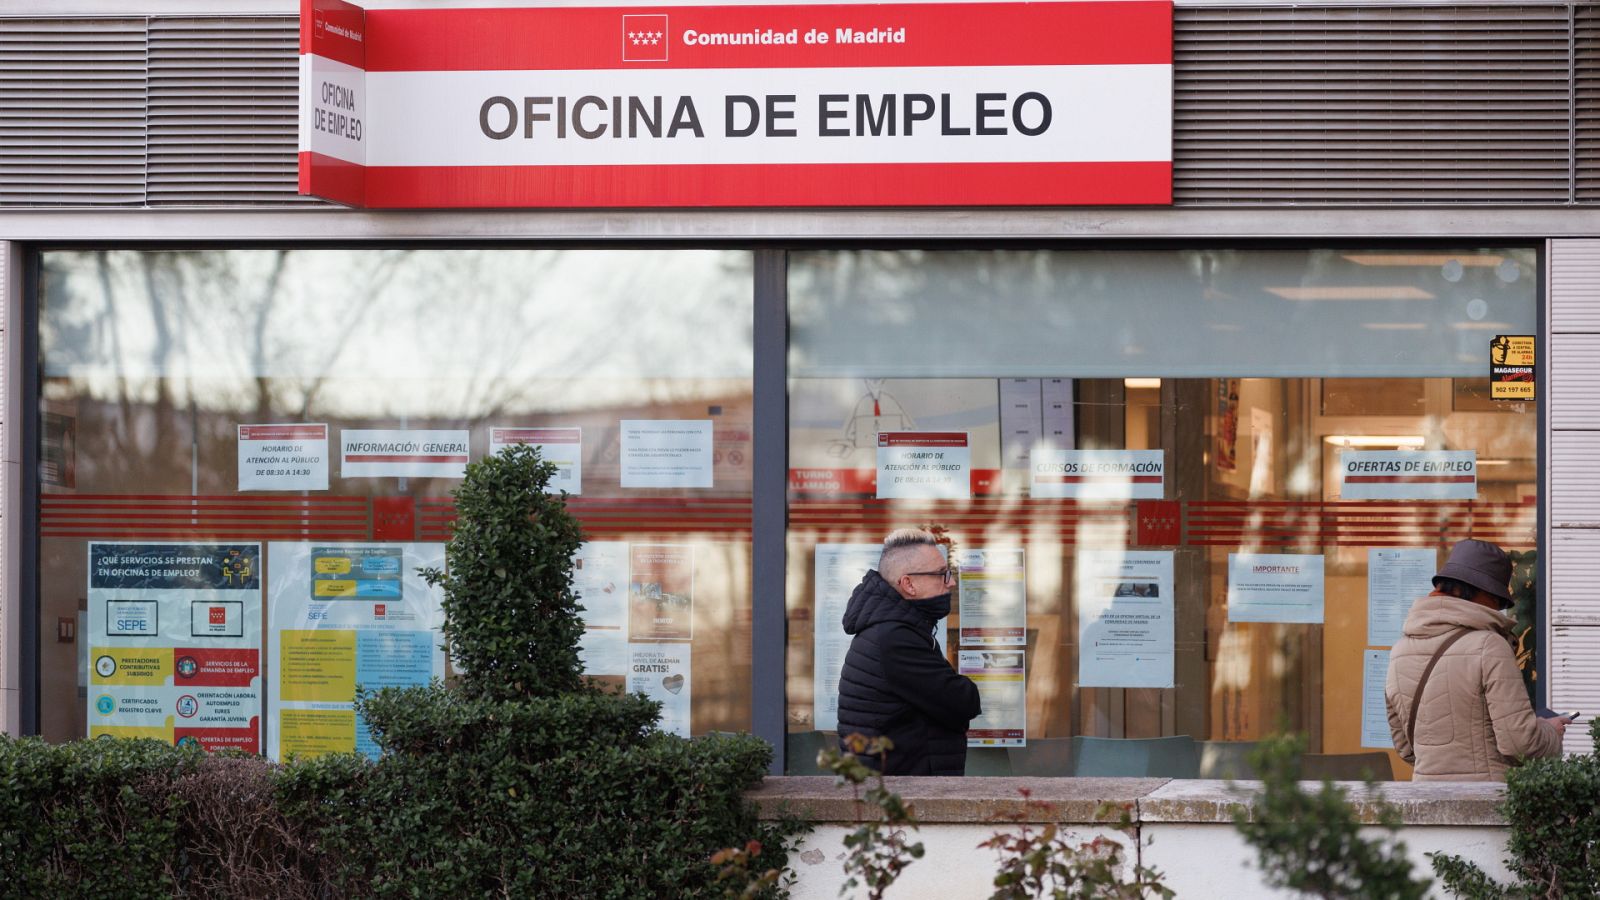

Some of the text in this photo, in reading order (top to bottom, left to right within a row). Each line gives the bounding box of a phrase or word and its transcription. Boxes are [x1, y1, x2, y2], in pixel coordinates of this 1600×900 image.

[682, 26, 906, 47] Comunidad de Madrid
[322, 81, 355, 112] OFICINA
[478, 91, 1053, 140] OFICINA DE EMPLEO
[314, 107, 362, 141] DE EMPLEO
[346, 441, 468, 453] INFORMACIÓN GENERAL
[246, 456, 280, 464] ATENCIÓN
[290, 455, 319, 464] PÚBLICO
[884, 463, 921, 471] ATENCIÓN
[931, 463, 960, 471] PÚBLICO
[1036, 460, 1162, 473] CURSOS DE FORMACIÓN
[1347, 460, 1472, 472] OFERTAS DE EMPLEO
[795, 471, 833, 479] TURNO
[98, 556, 118, 566] ¿QUÉ
[112, 569, 150, 577] OFICINAS
[1252, 565, 1299, 574] IMPORTANTE
[117, 620, 147, 630] SEPE
